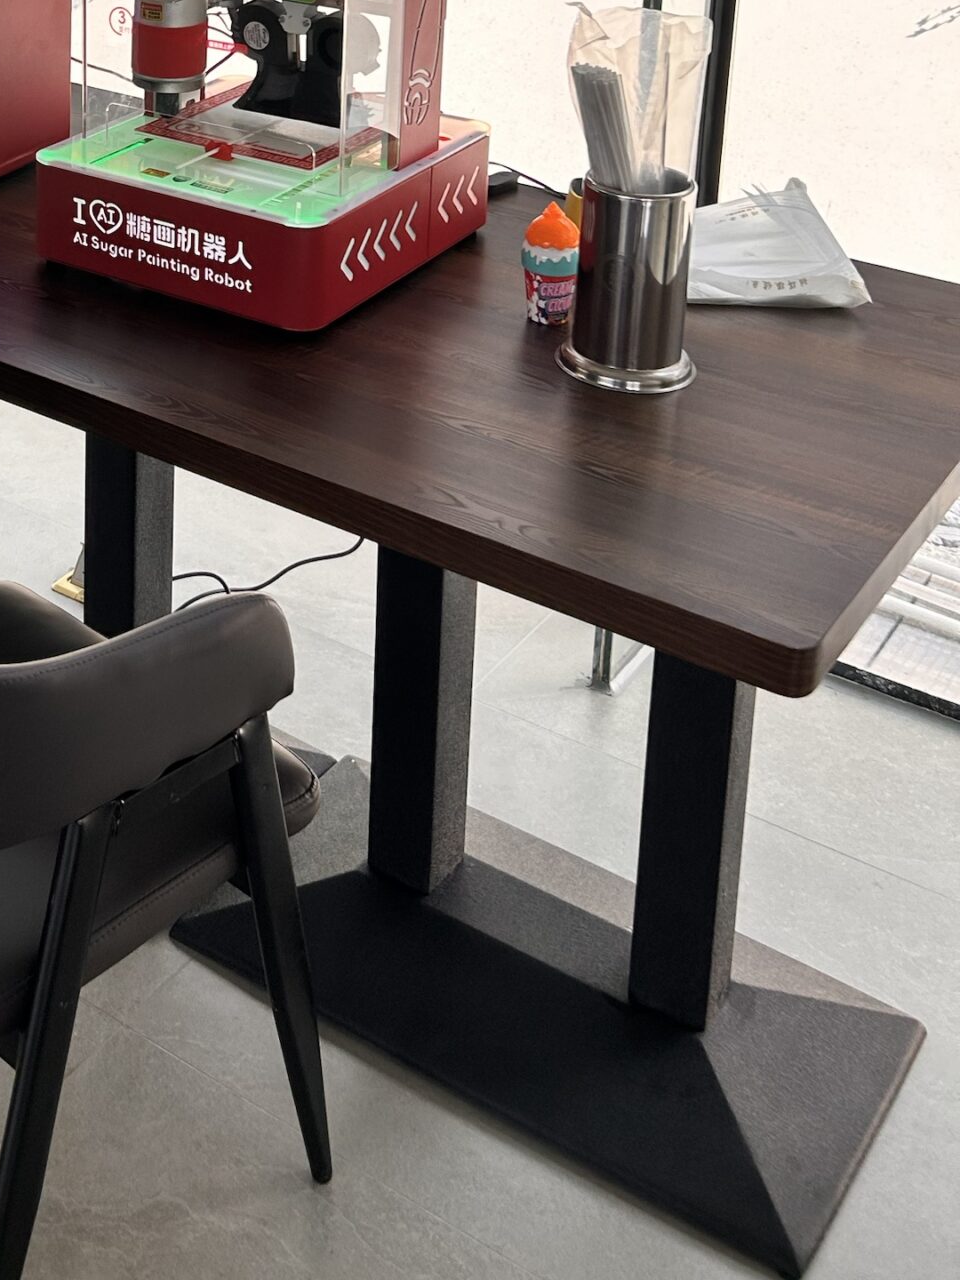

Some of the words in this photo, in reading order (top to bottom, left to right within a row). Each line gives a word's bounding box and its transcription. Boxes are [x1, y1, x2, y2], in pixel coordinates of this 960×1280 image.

[72, 196, 87, 225] I
[126, 212, 253, 270] 糖画机器人
[73, 231, 88, 247] AI
[91, 235, 134, 259] Sugar
[137, 248, 200, 281] Painting
[204, 267, 253, 293] Robot
